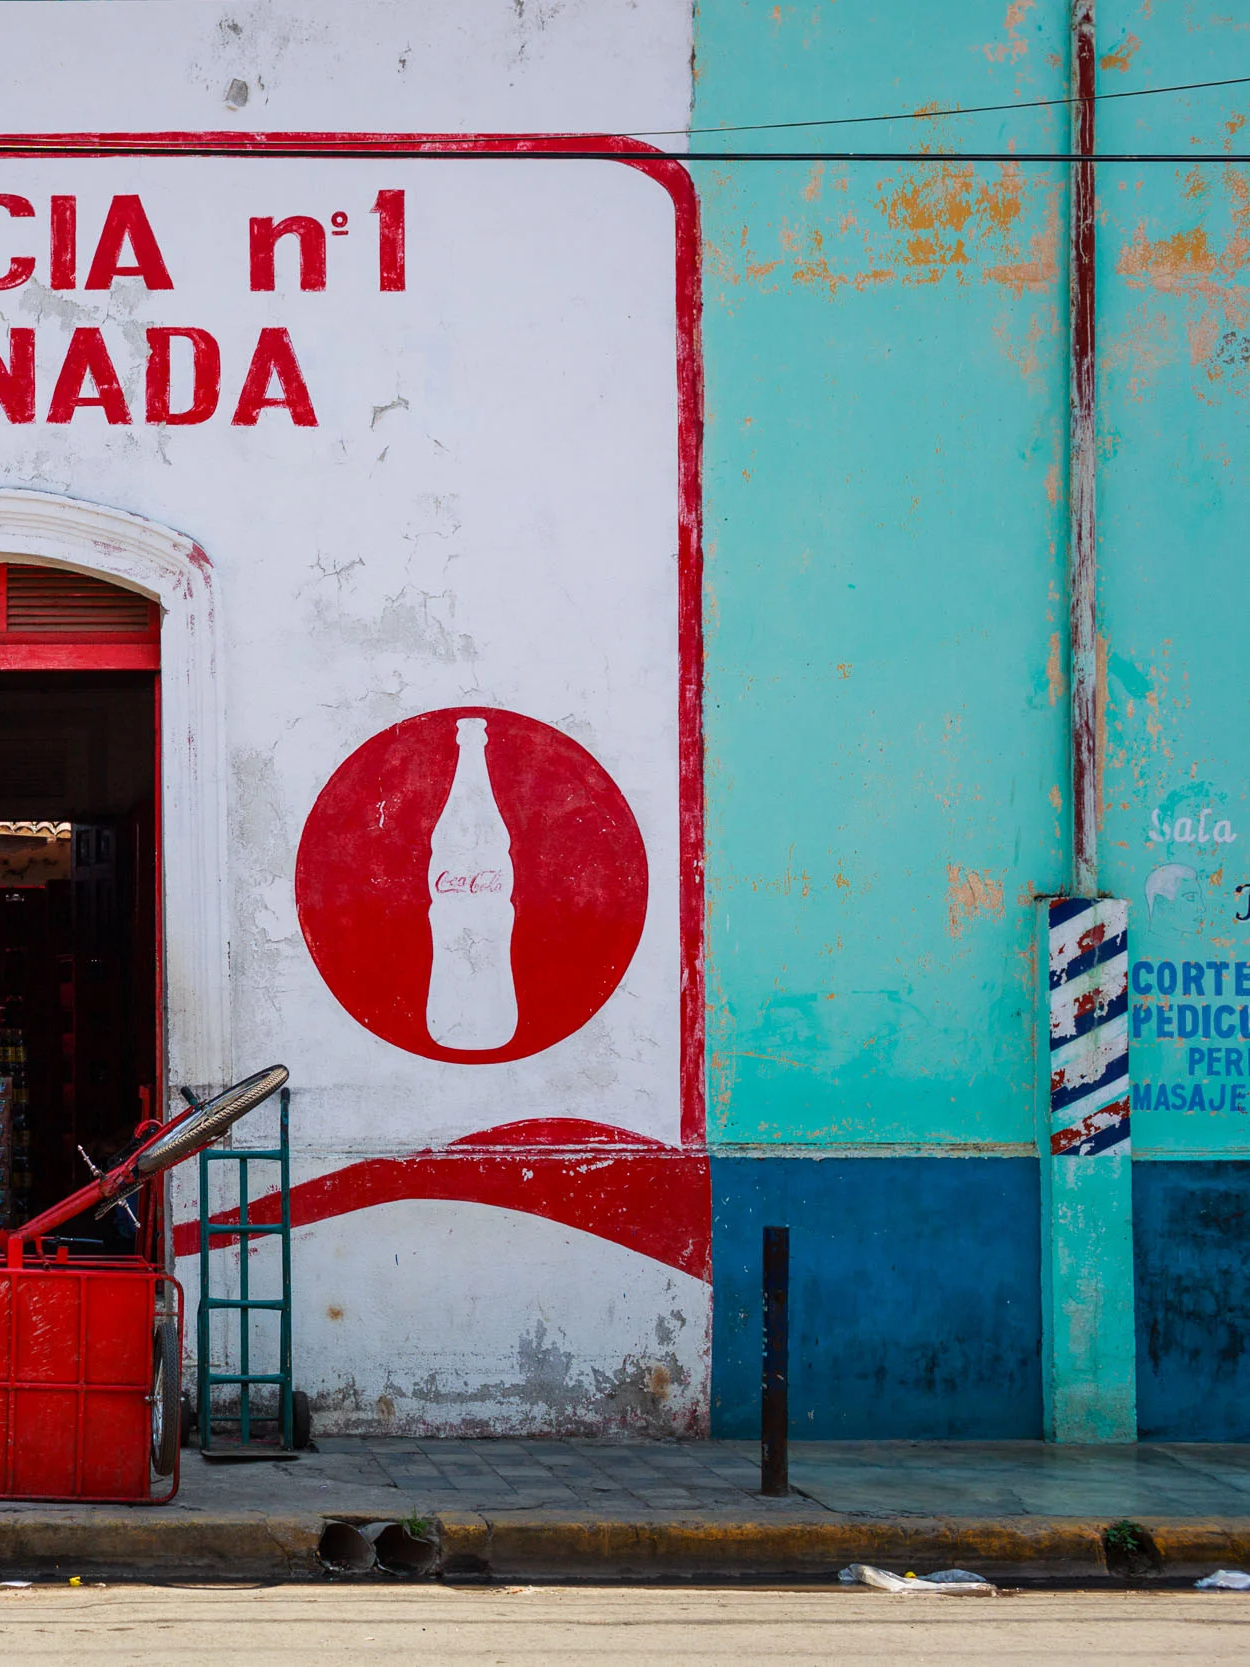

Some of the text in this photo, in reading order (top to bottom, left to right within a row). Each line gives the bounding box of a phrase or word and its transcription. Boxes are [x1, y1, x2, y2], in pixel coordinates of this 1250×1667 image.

[371, 189, 407, 293] 1
[1150, 809, 1237, 843] Sala
[1188, 1047, 1250, 1078] PER
